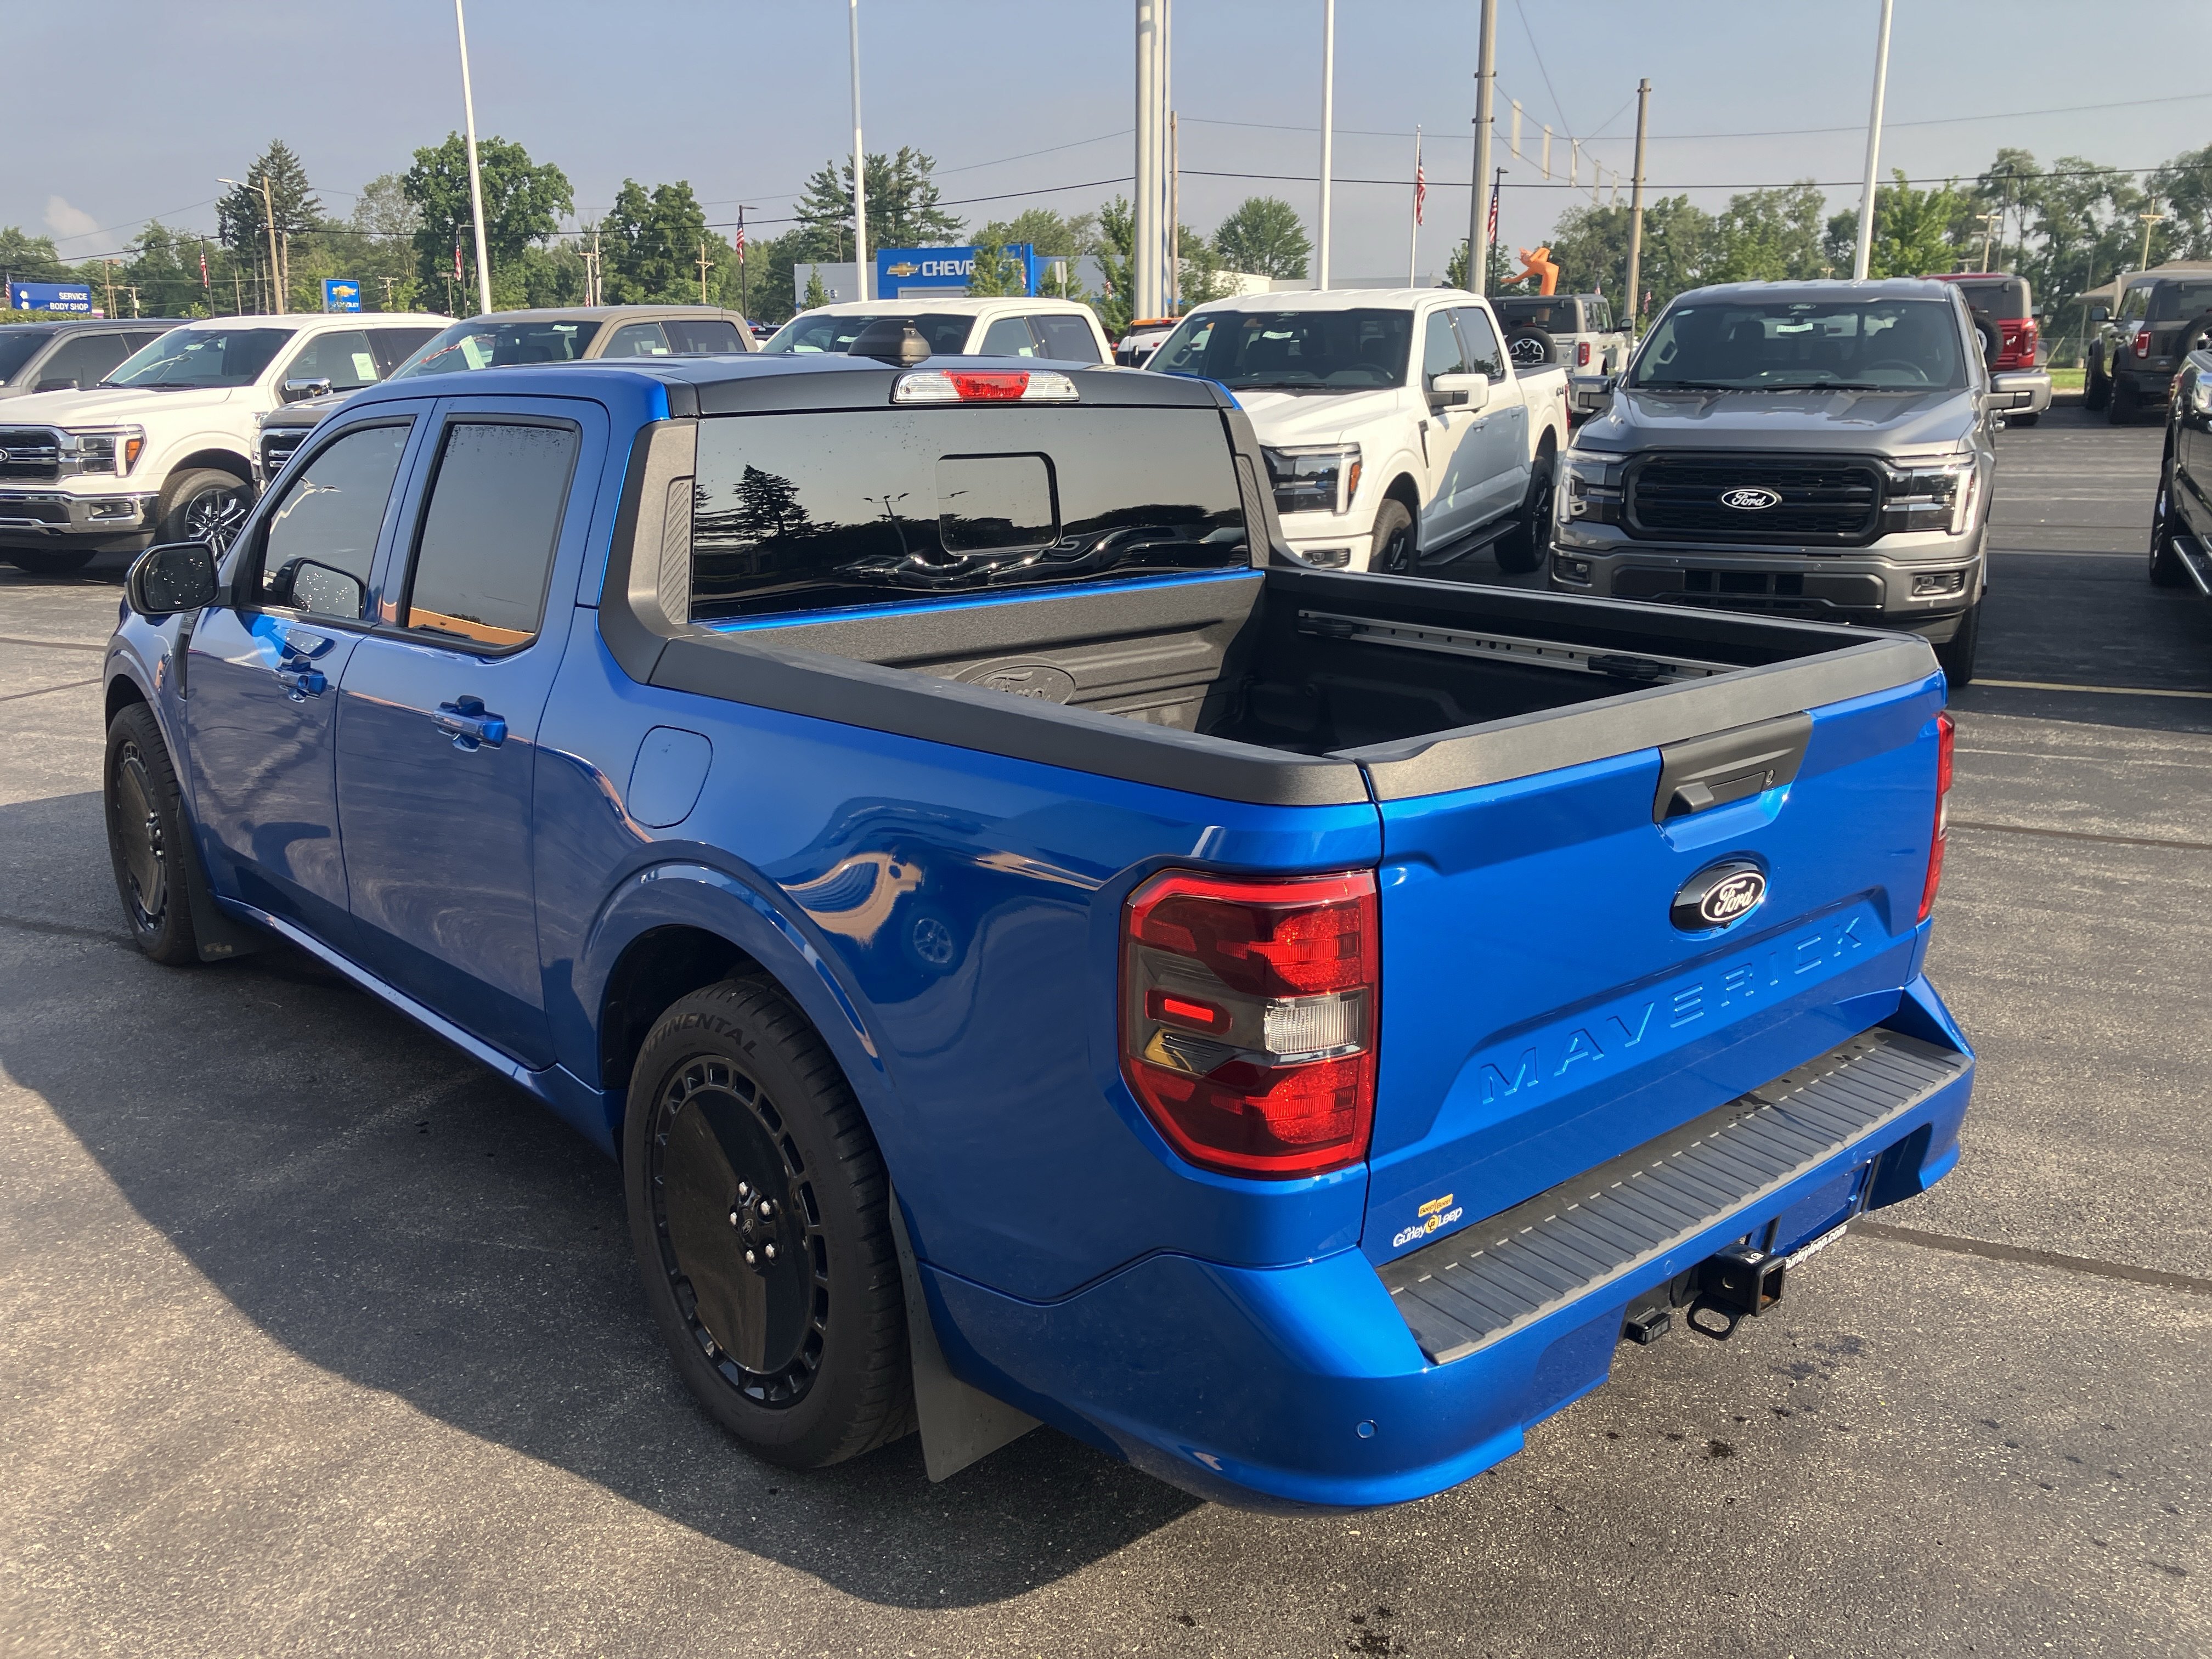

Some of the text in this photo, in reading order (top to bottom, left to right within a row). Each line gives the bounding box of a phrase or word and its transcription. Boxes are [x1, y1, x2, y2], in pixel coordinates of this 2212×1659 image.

[59, 292, 88, 301] SERVICE
[1731, 492, 1767, 506] Ford
[1714, 880, 1756, 917] Ford
[1480, 916, 1863, 1104] MAVERICK
[1393, 1223, 1426, 1248] Gurley
[1437, 1207, 1463, 1227] Leep
[1785, 1224, 1847, 1270] urleyleep.com
